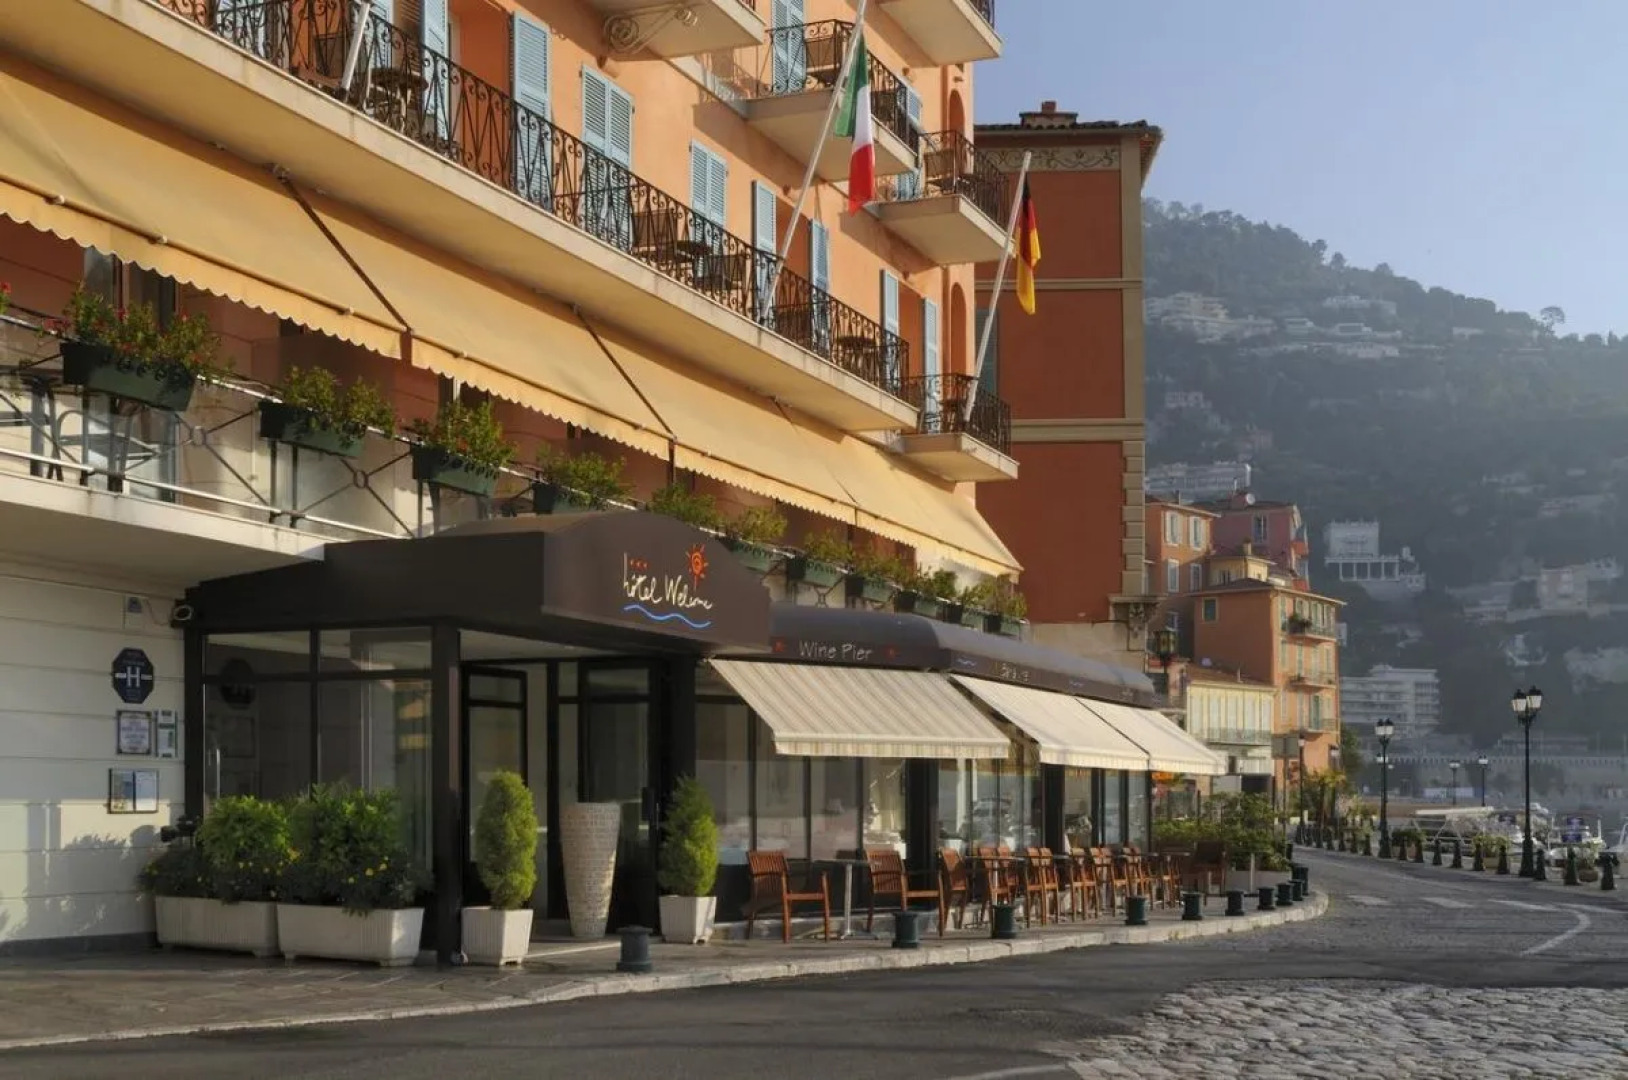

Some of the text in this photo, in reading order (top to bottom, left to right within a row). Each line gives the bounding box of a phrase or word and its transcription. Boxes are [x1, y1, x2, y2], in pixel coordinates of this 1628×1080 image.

[799, 640, 873, 660] Wine Pier
[126, 666, 141, 688] H
